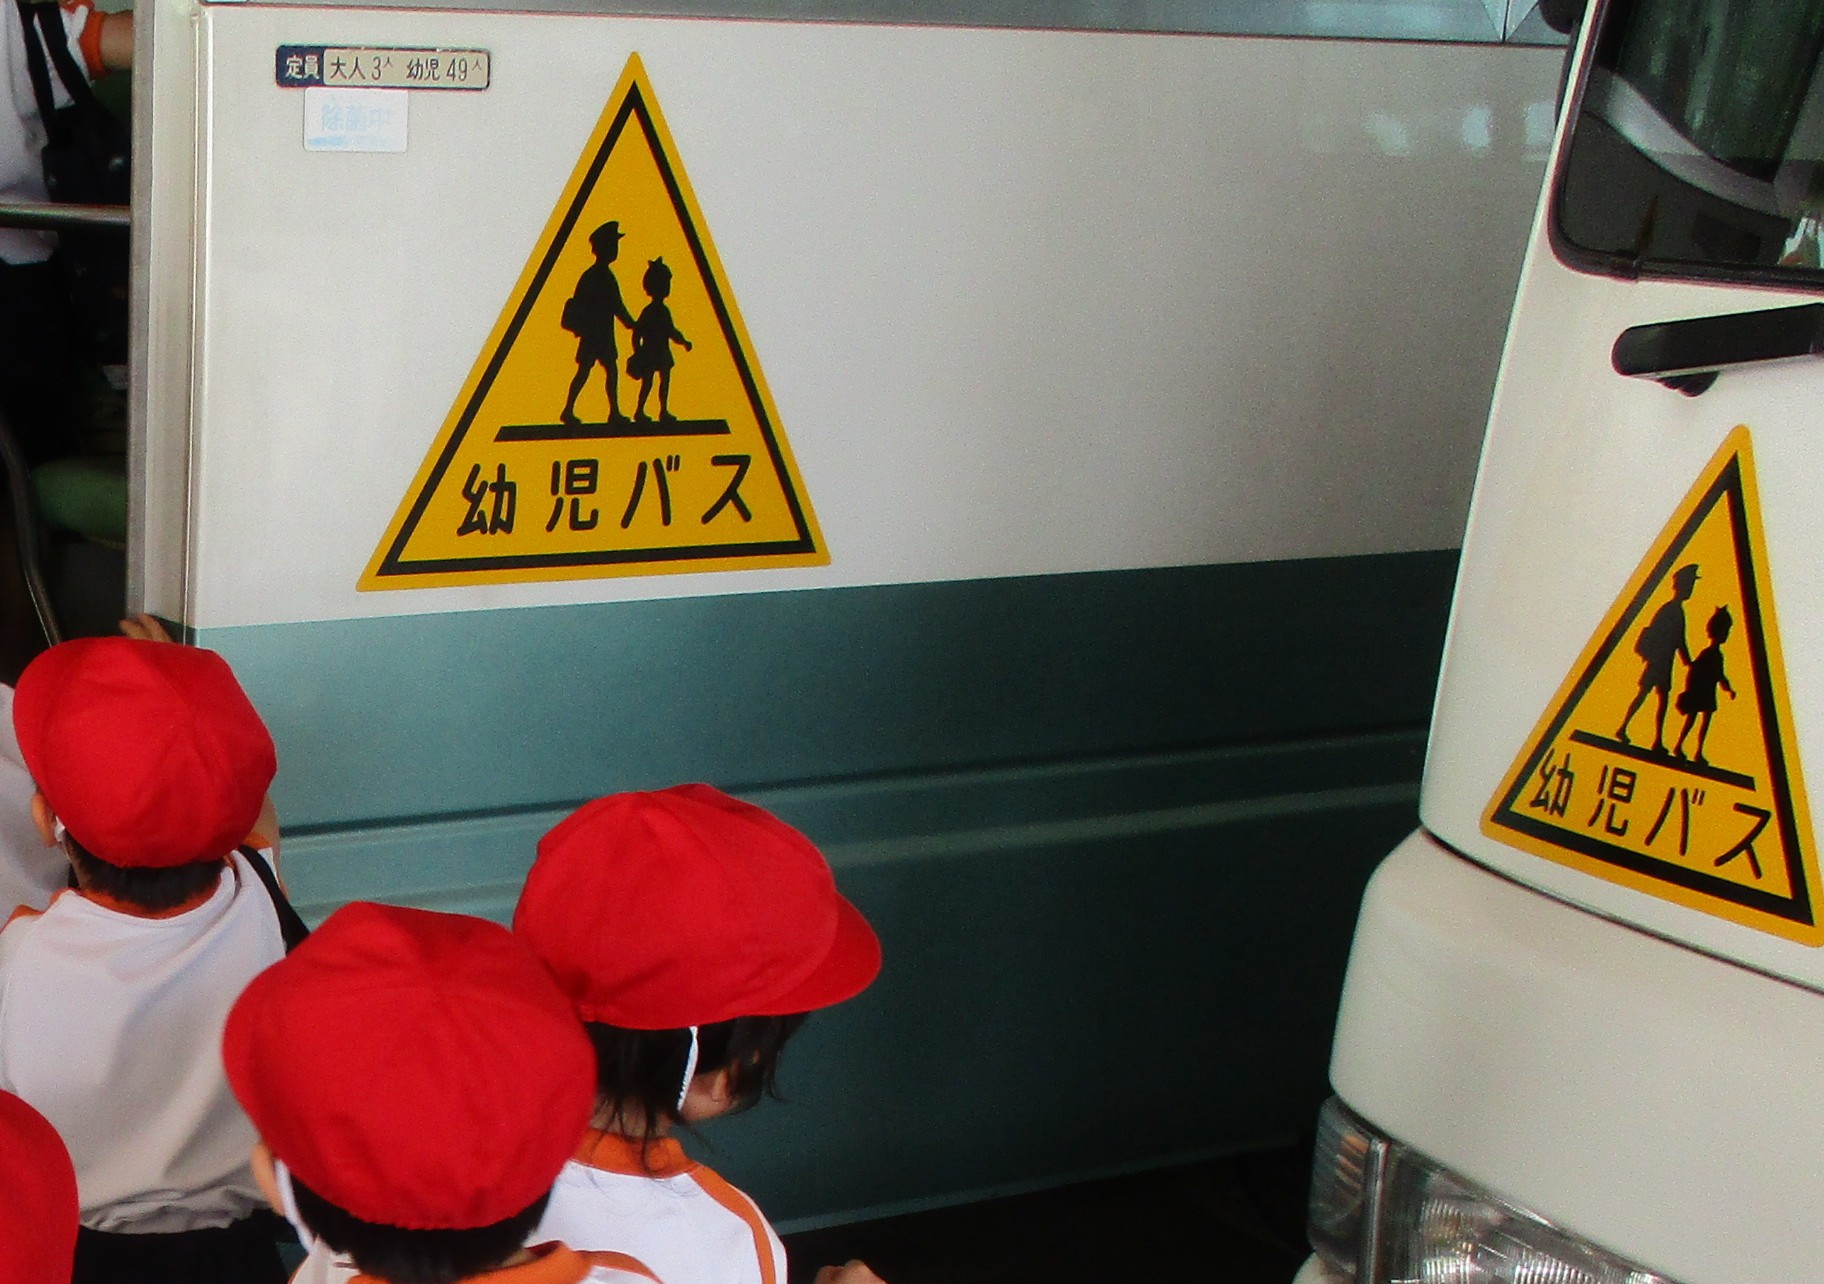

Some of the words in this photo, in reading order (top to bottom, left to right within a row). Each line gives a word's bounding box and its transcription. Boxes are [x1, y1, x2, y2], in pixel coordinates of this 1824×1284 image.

[285, 54, 320, 80] 定員
[456, 454, 752, 537] 幼児バス
[1529, 748, 1773, 880] 幼児バス
